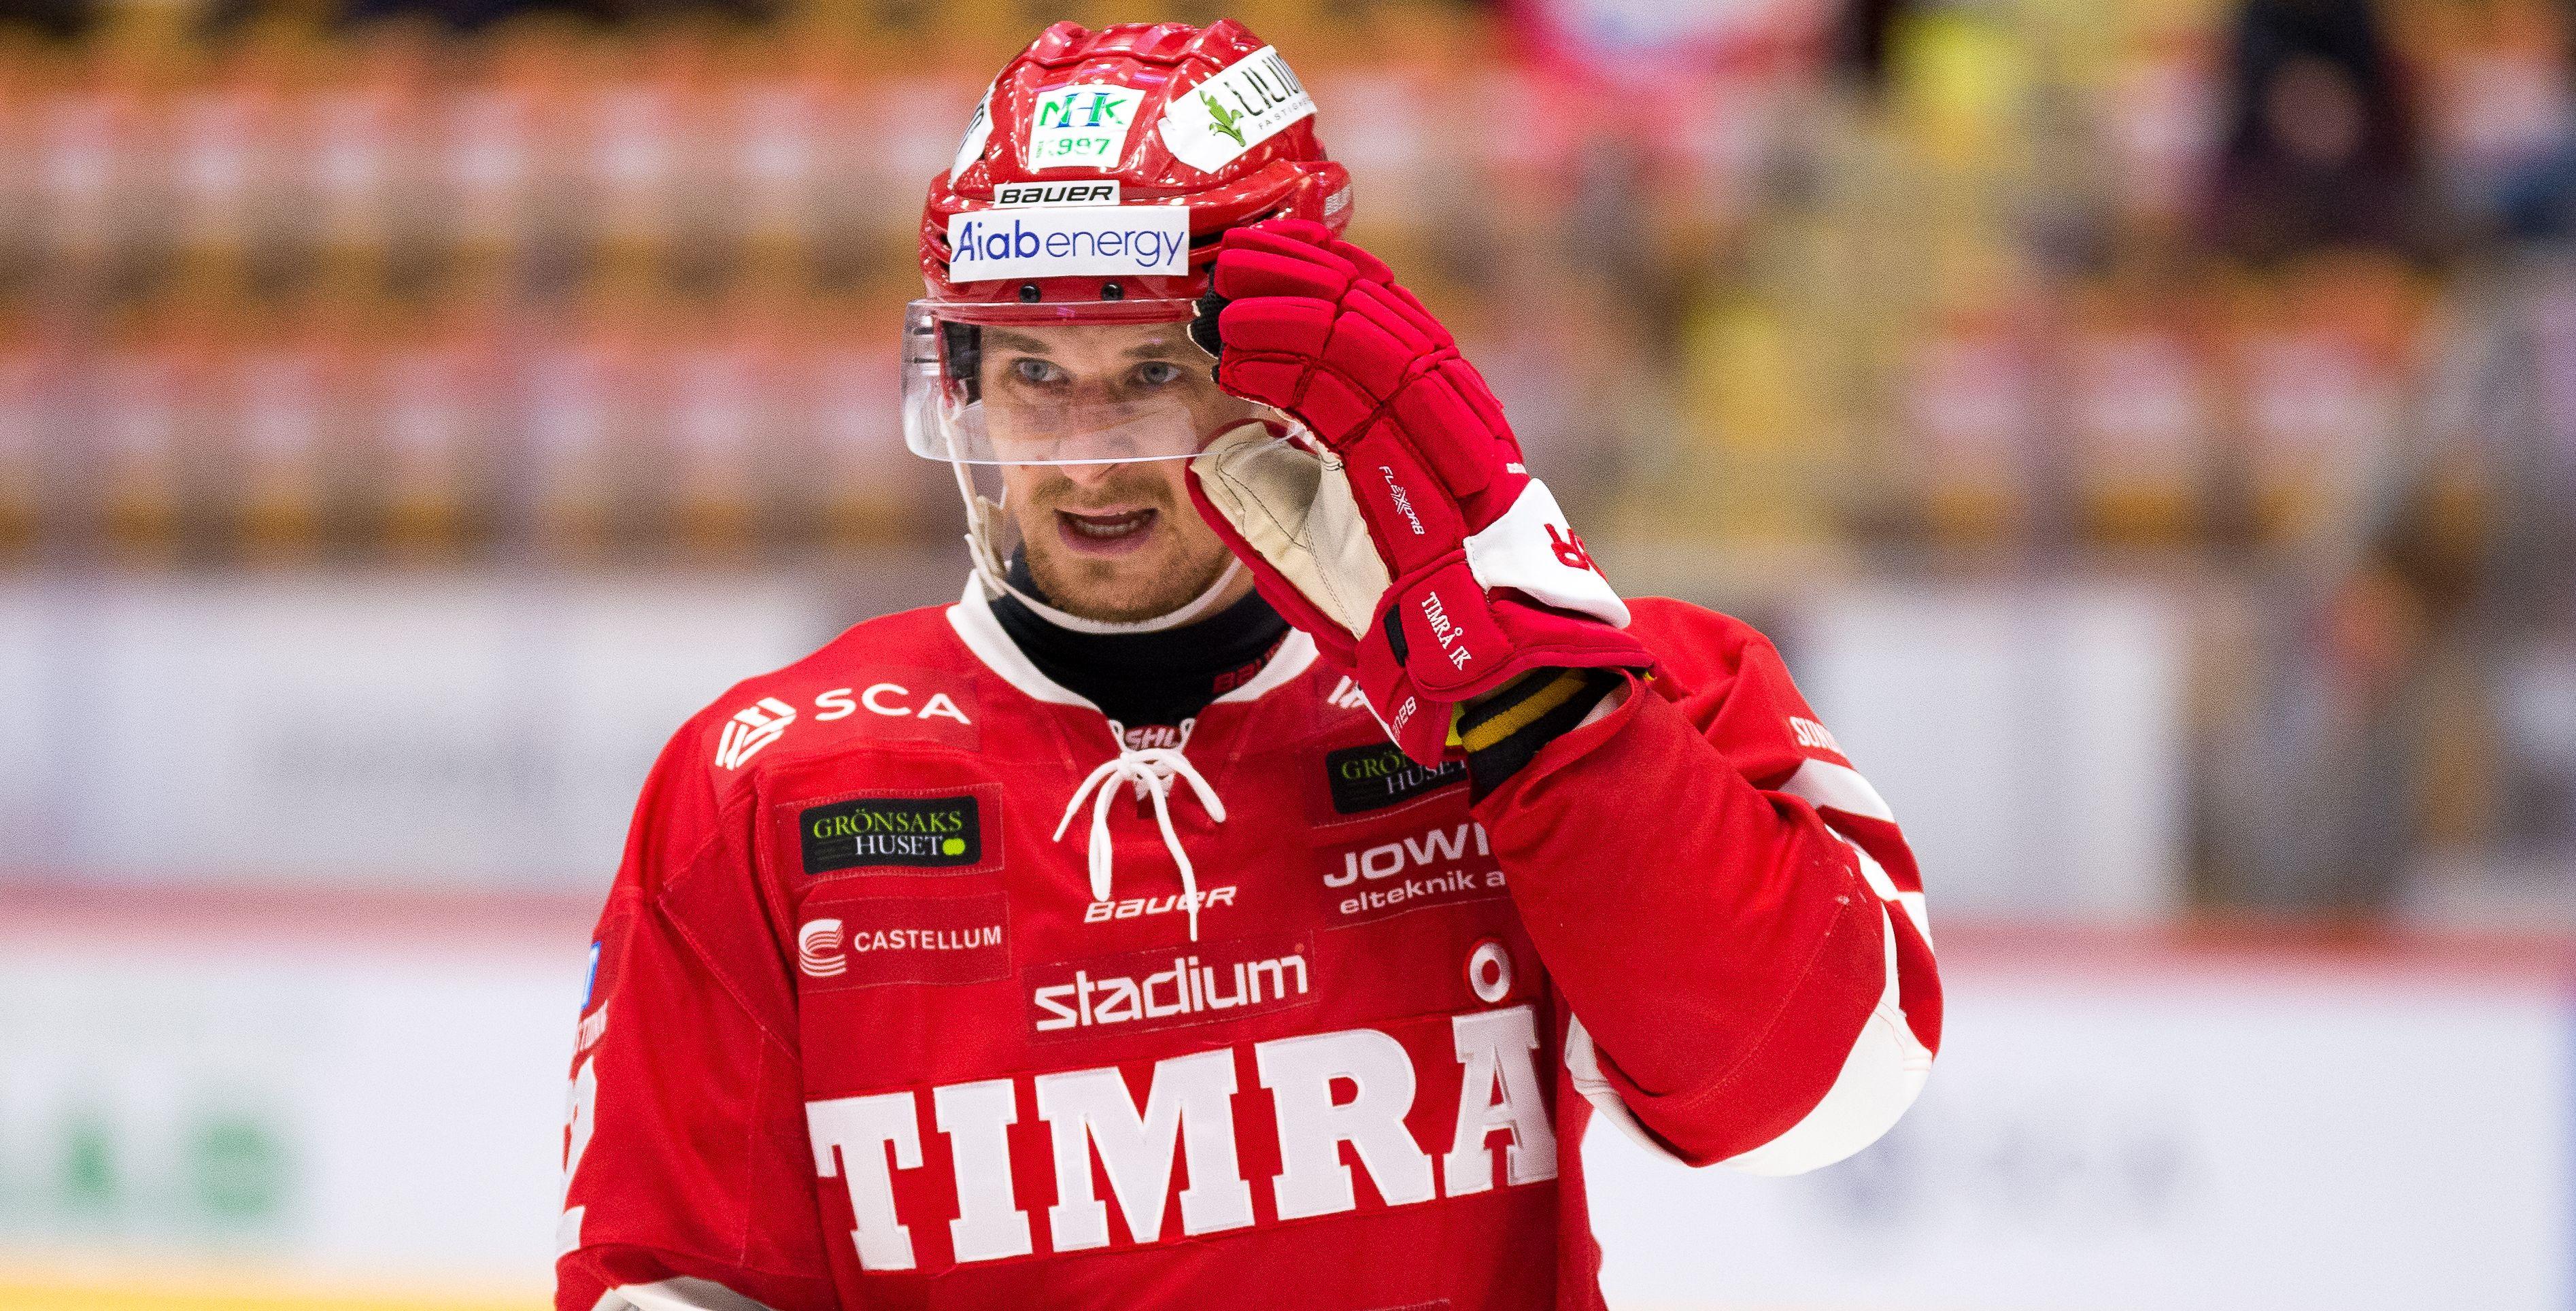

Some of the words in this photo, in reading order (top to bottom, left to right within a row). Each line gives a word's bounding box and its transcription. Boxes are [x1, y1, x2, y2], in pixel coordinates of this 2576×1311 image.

[999, 185, 1115, 204] BAUER
[1421, 591, 1463, 649] TIMRÅ
[1448, 645, 1472, 670] IK
[815, 683, 972, 725] SCA
[813, 808, 963, 839] GRÖNSAKS
[854, 834, 943, 856] HUSET
[1340, 870, 1477, 915] elteknik
[854, 925, 1001, 952] CASTELLUM
[1034, 955, 1308, 1032] stadium
[805, 942, 1557, 1272] TIMRÅ
